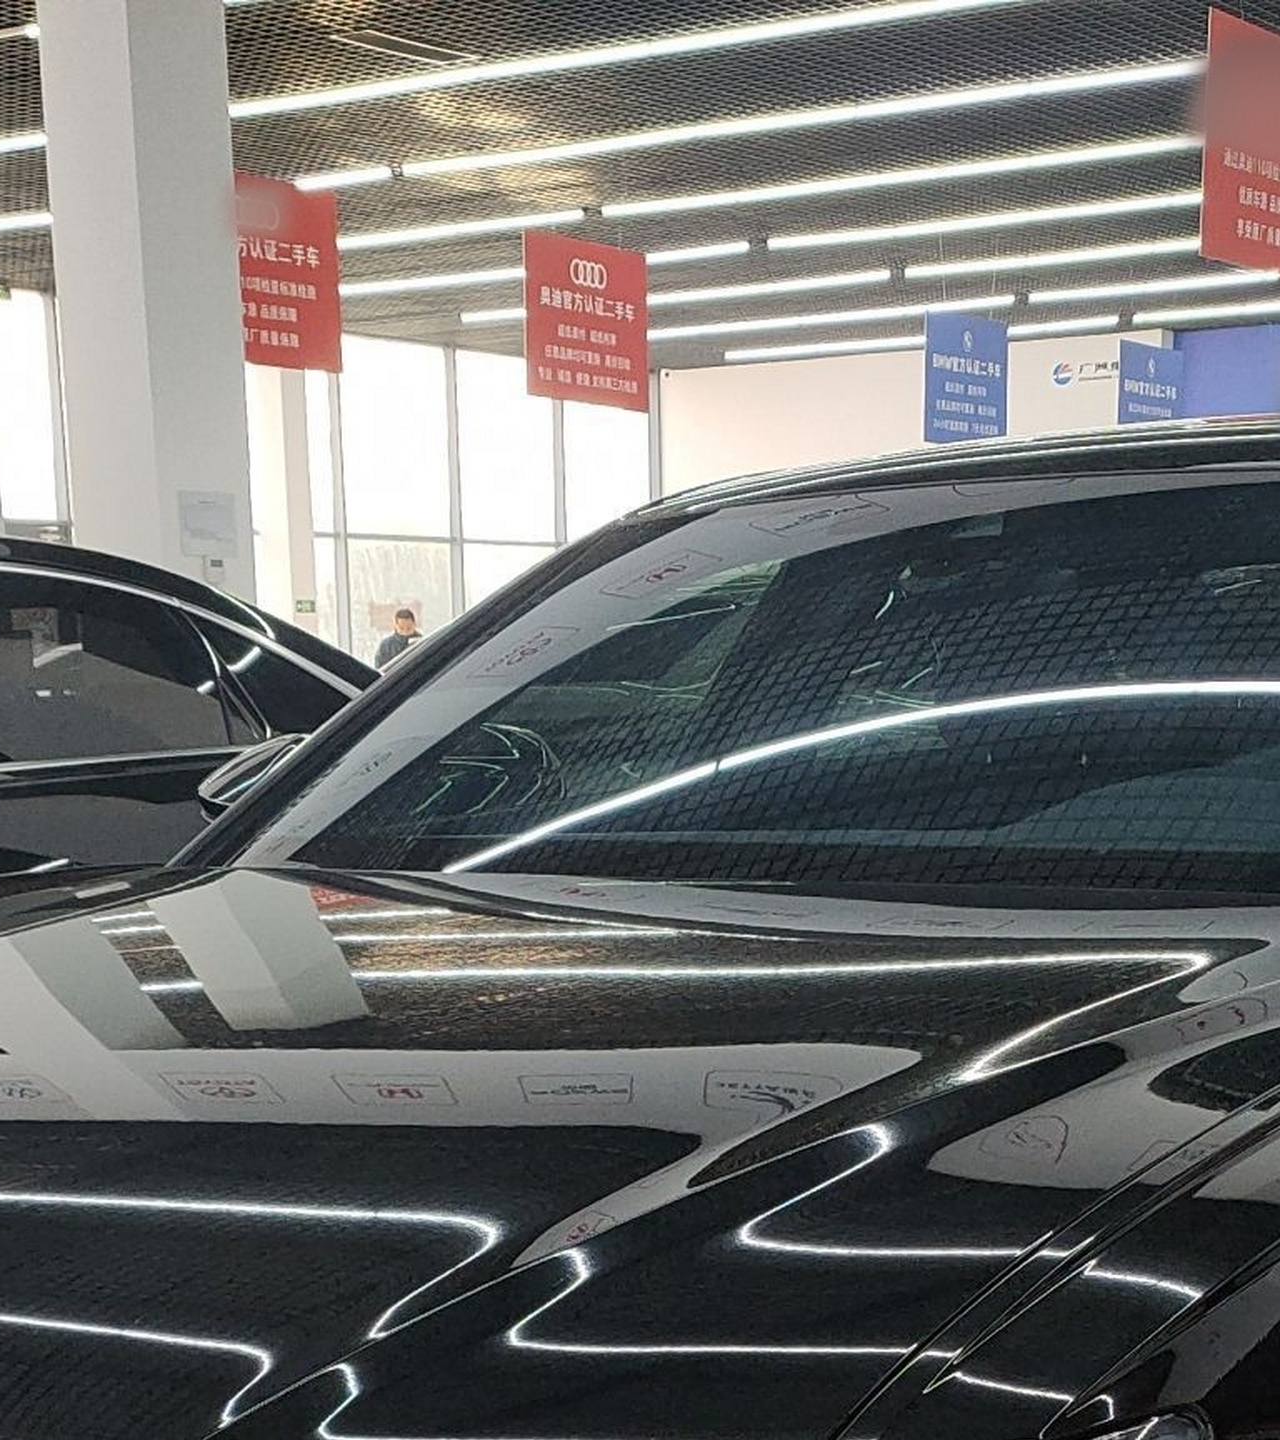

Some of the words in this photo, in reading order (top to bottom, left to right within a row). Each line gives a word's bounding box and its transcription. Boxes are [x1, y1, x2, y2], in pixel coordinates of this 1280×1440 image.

[539, 285, 637, 324] 奥迪官方认证二手车
